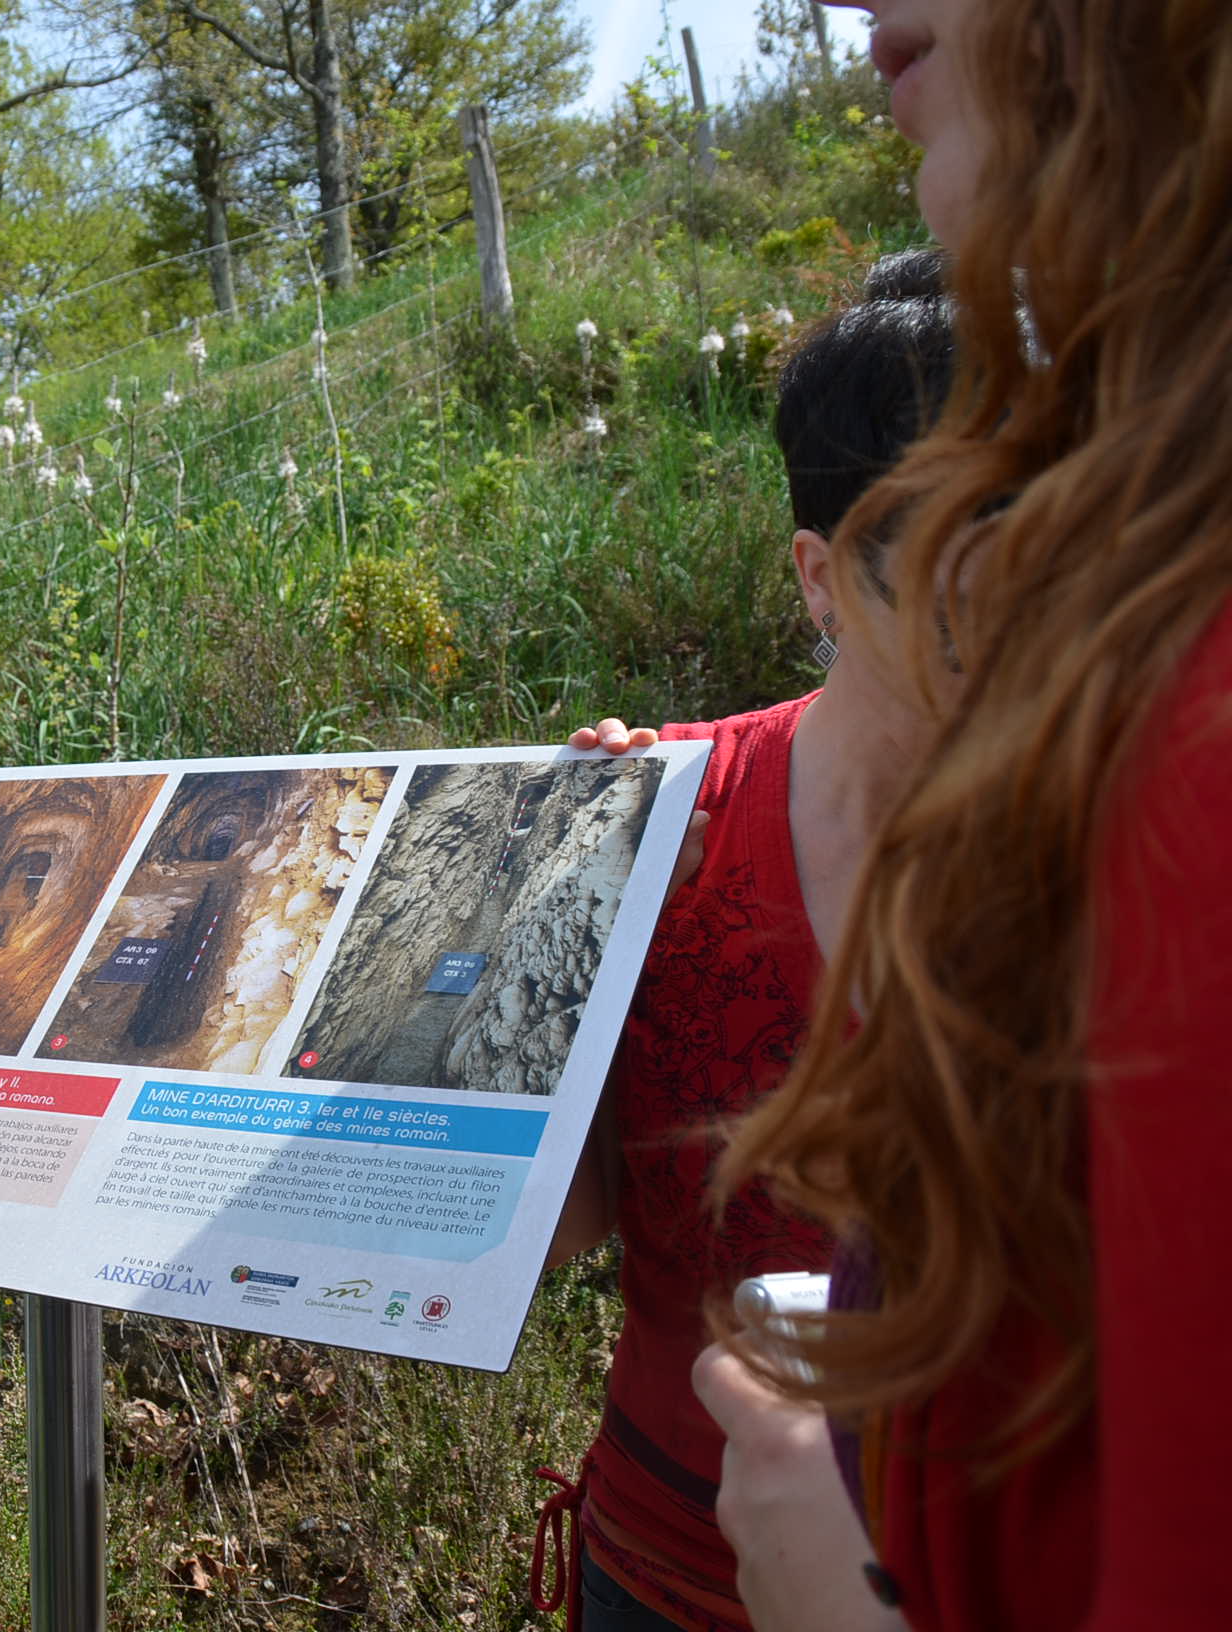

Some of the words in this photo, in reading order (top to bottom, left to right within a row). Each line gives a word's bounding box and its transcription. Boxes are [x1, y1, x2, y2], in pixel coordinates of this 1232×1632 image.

[140, 1105, 159, 1115] Un
[162, 1106, 188, 1118] bon
[190, 1111, 248, 1125] exemple
[251, 1114, 270, 1125] du
[272, 1117, 312, 1129] génie
[315, 1120, 342, 1132] des
[346, 1125, 391, 1136] mines
[394, 1129, 449, 1142] romain.
[147, 1089, 191, 1103] MINE
[192, 1093, 295, 1112] D'ARDITURRI
[296, 1101, 310, 1114] 3.
[342, 1107, 360, 1118] et
[387, 1110, 450, 1126] siècles.
[11, 1133, 33, 1142] para
[126, 1132, 153, 1143] Dans
[153, 1135, 162, 1144] la
[161, 1138, 192, 1148] partie
[193, 1139, 224, 1150] haute
[224, 1142, 239, 1152] de
[240, 1143, 250, 1153] la
[251, 1146, 279, 1156] mine
[280, 1149, 300, 1158] ont
[300, 1149, 320, 1160] été
[320, 1151, 383, 1166] découverts
[385, 1157, 402, 1168] les
[403, 1160, 446, 1172] travaux
[448, 1165, 505, 1178] auxiliaires
[120, 1145, 169, 1158] effectués
[171, 1152, 199, 1162] pour
[268, 1160, 284, 1170] de
[287, 1161, 298, 1171] la
[300, 1164, 343, 1176] galerie
[346, 1168, 363, 1178] de
[366, 1172, 444, 1187] prospection
[448, 1178, 466, 1189] du
[471, 1180, 500, 1193] filon
[173, 1165, 198, 1174] sont
[198, 1168, 247, 1179] vraiment
[248, 1173, 331, 1189] extraordinaires
[333, 1181, 347, 1190] et
[417, 1190, 468, 1204] incluant
[470, 1197, 496, 1207] une
[94, 1196, 114, 1206] par
[114, 1196, 130, 1206] les
[131, 1200, 170, 1211] miniers
[102, 1181, 116, 1191] fin
[118, 1184, 151, 1196] travail
[152, 1187, 167, 1198] de
[169, 1190, 196, 1201] taille
[196, 1195, 217, 1205] qui
[219, 1195, 258, 1209] fignole
[261, 1200, 278, 1211] les
[280, 1204, 311, 1215] murs
[313, 1206, 372, 1223] témoigne
[375, 1213, 393, 1225] du
[396, 1217, 438, 1230] niveau
[441, 1222, 486, 1236] atteint
[106, 1170, 138, 1183] jauge
[149, 1175, 169, 1184] ciel
[170, 1178, 206, 1188] ouvert
[206, 1182, 227, 1193] qui
[229, 1185, 251, 1193] sert
[339, 1197, 348, 1205] à
[350, 1196, 361, 1206] la
[364, 1197, 412, 1212] bouche
[474, 1210, 491, 1221] Le
[94, 1263, 213, 1297] ARKEOLAN
[122, 1256, 194, 1273] FUNDACIÓN
